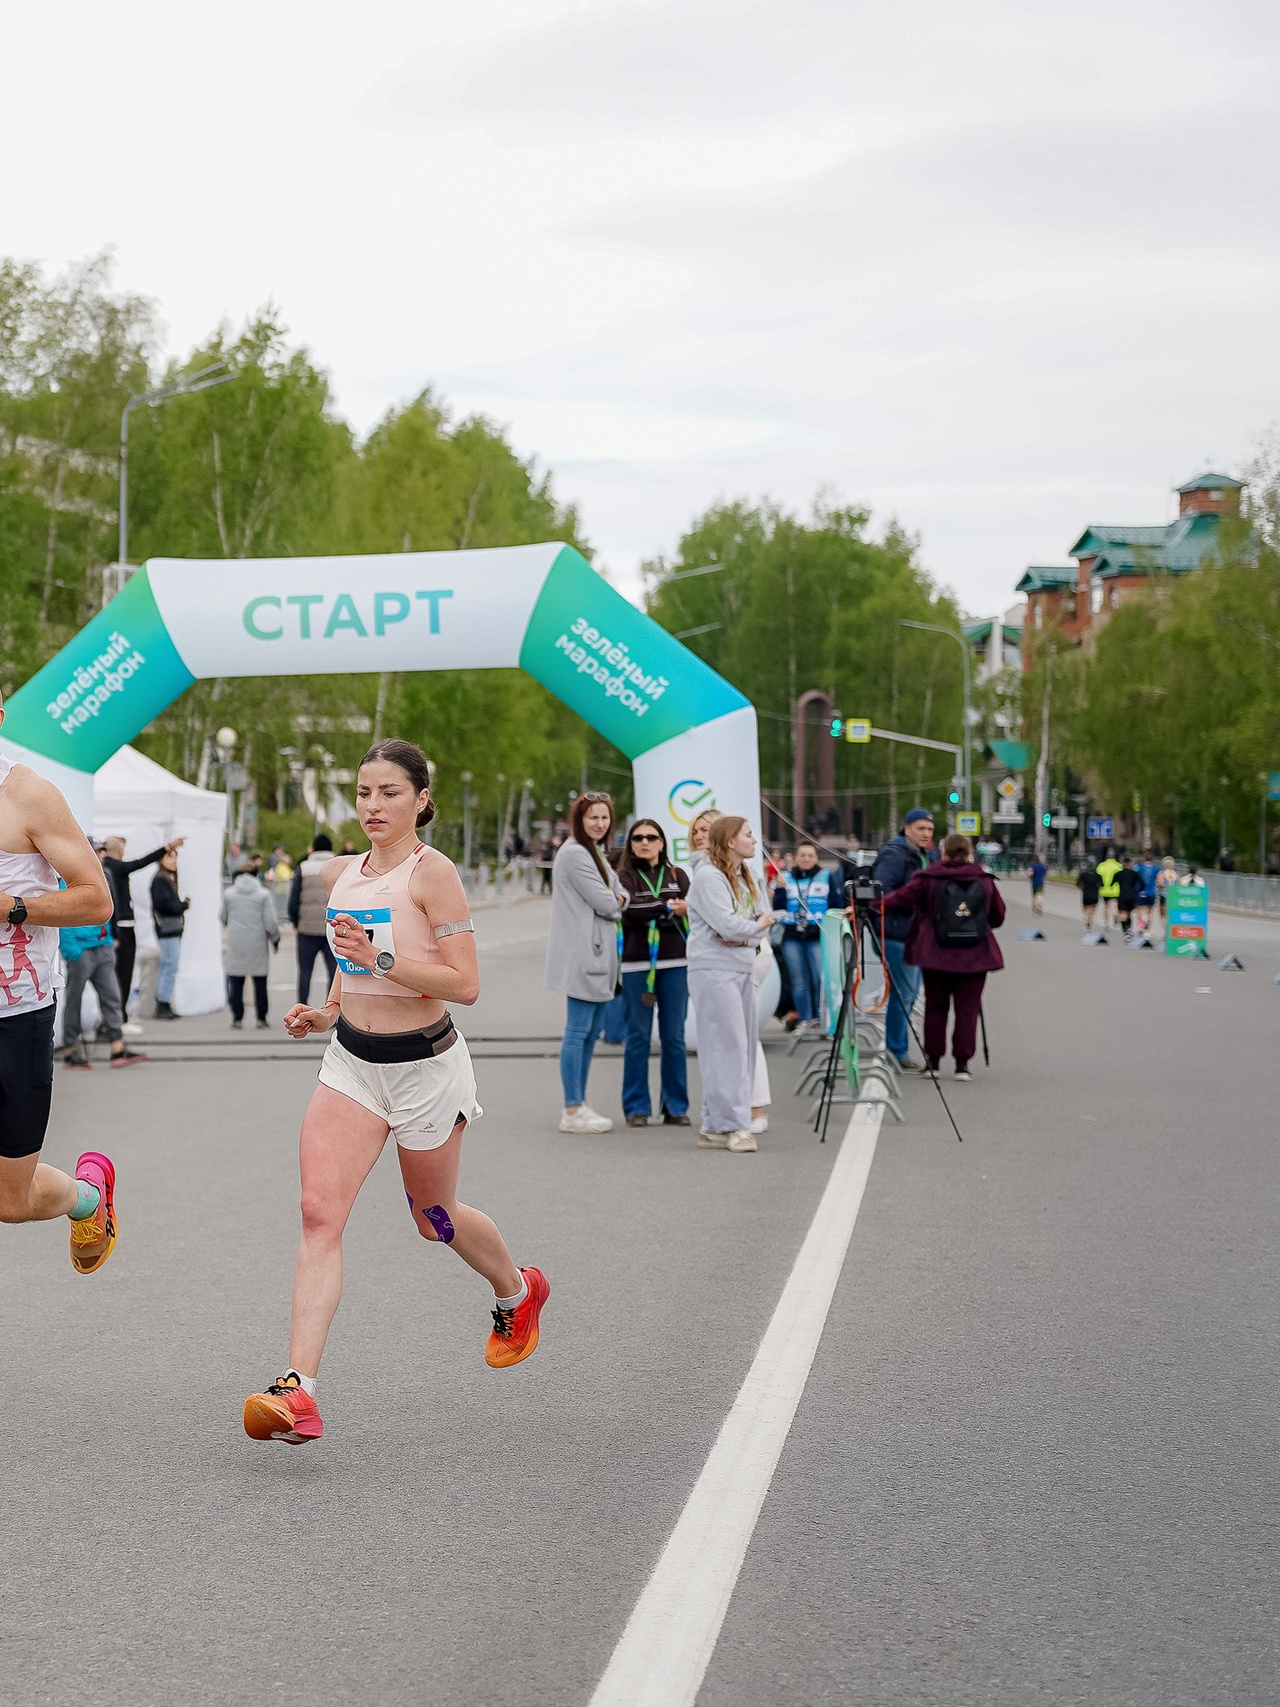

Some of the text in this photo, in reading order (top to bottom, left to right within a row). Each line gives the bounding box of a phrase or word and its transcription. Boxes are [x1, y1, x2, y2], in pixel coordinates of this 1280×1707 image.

[242, 590, 454, 641] СТАРТ
[46, 631, 131, 719] зелёный
[60, 651, 146, 735] марафон
[555, 634, 650, 717] марафон
[570, 617, 669, 701] зелёный
